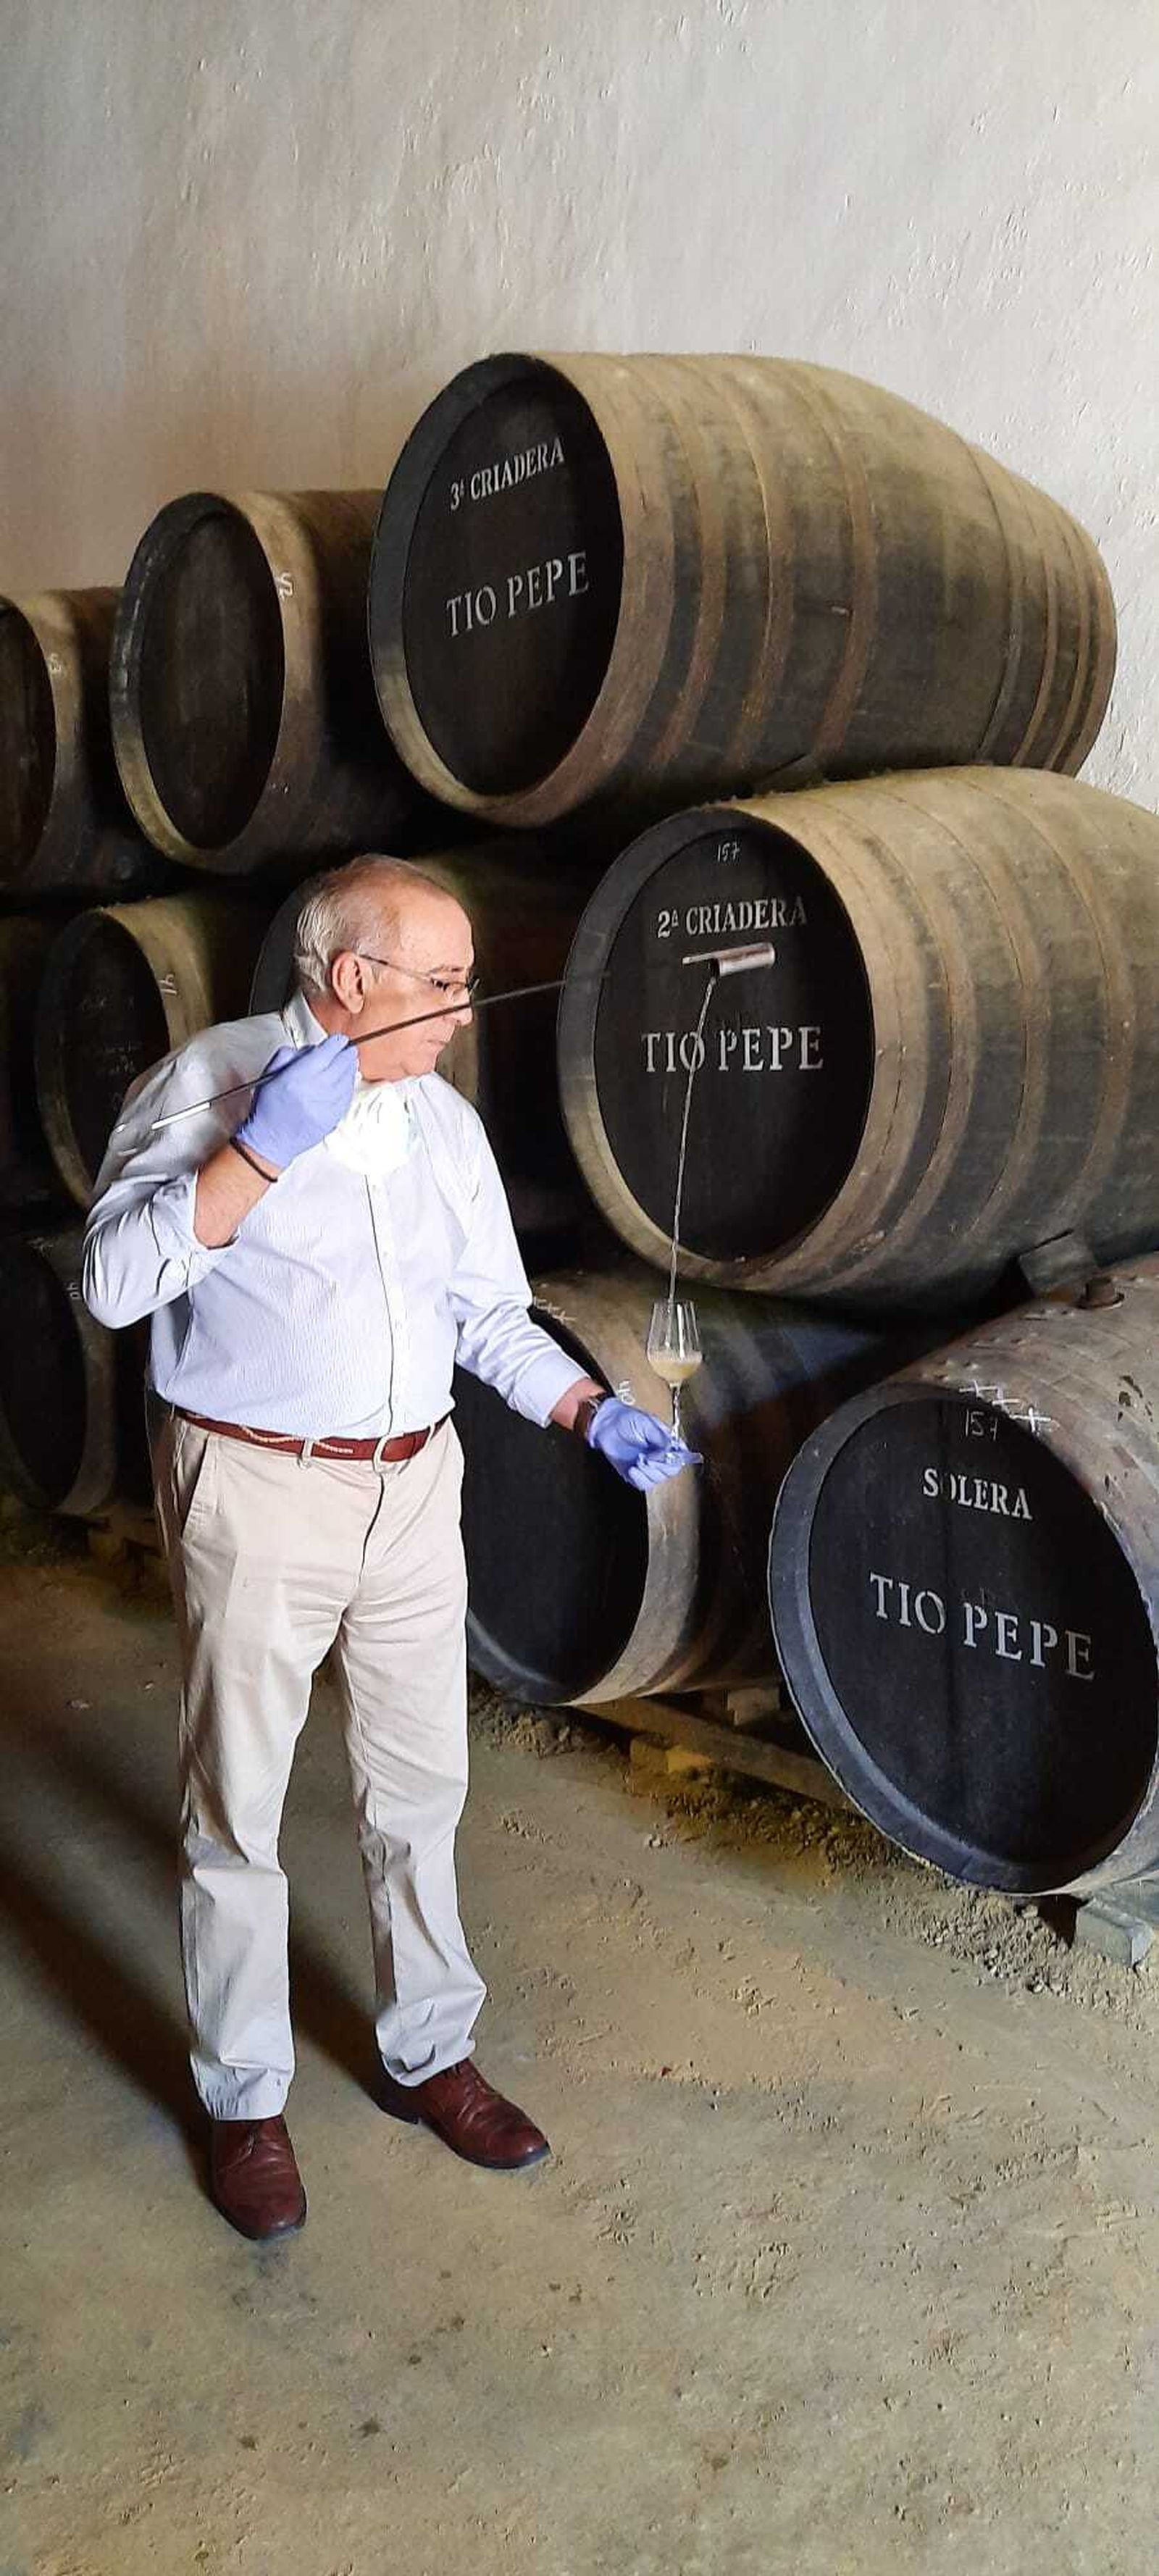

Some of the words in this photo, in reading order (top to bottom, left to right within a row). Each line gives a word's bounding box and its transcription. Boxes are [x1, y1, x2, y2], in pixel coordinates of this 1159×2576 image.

[470, 437, 564, 500] CRIADERA
[446, 585, 497, 637] TIO
[507, 552, 589, 619] PEPE
[685, 896, 808, 935] CRIADERA
[641, 1032, 706, 1072] TIO
[717, 1026, 824, 1071] PEPE
[870, 1572, 947, 1634] TIO
[963, 1602, 1095, 1680] PEPE
